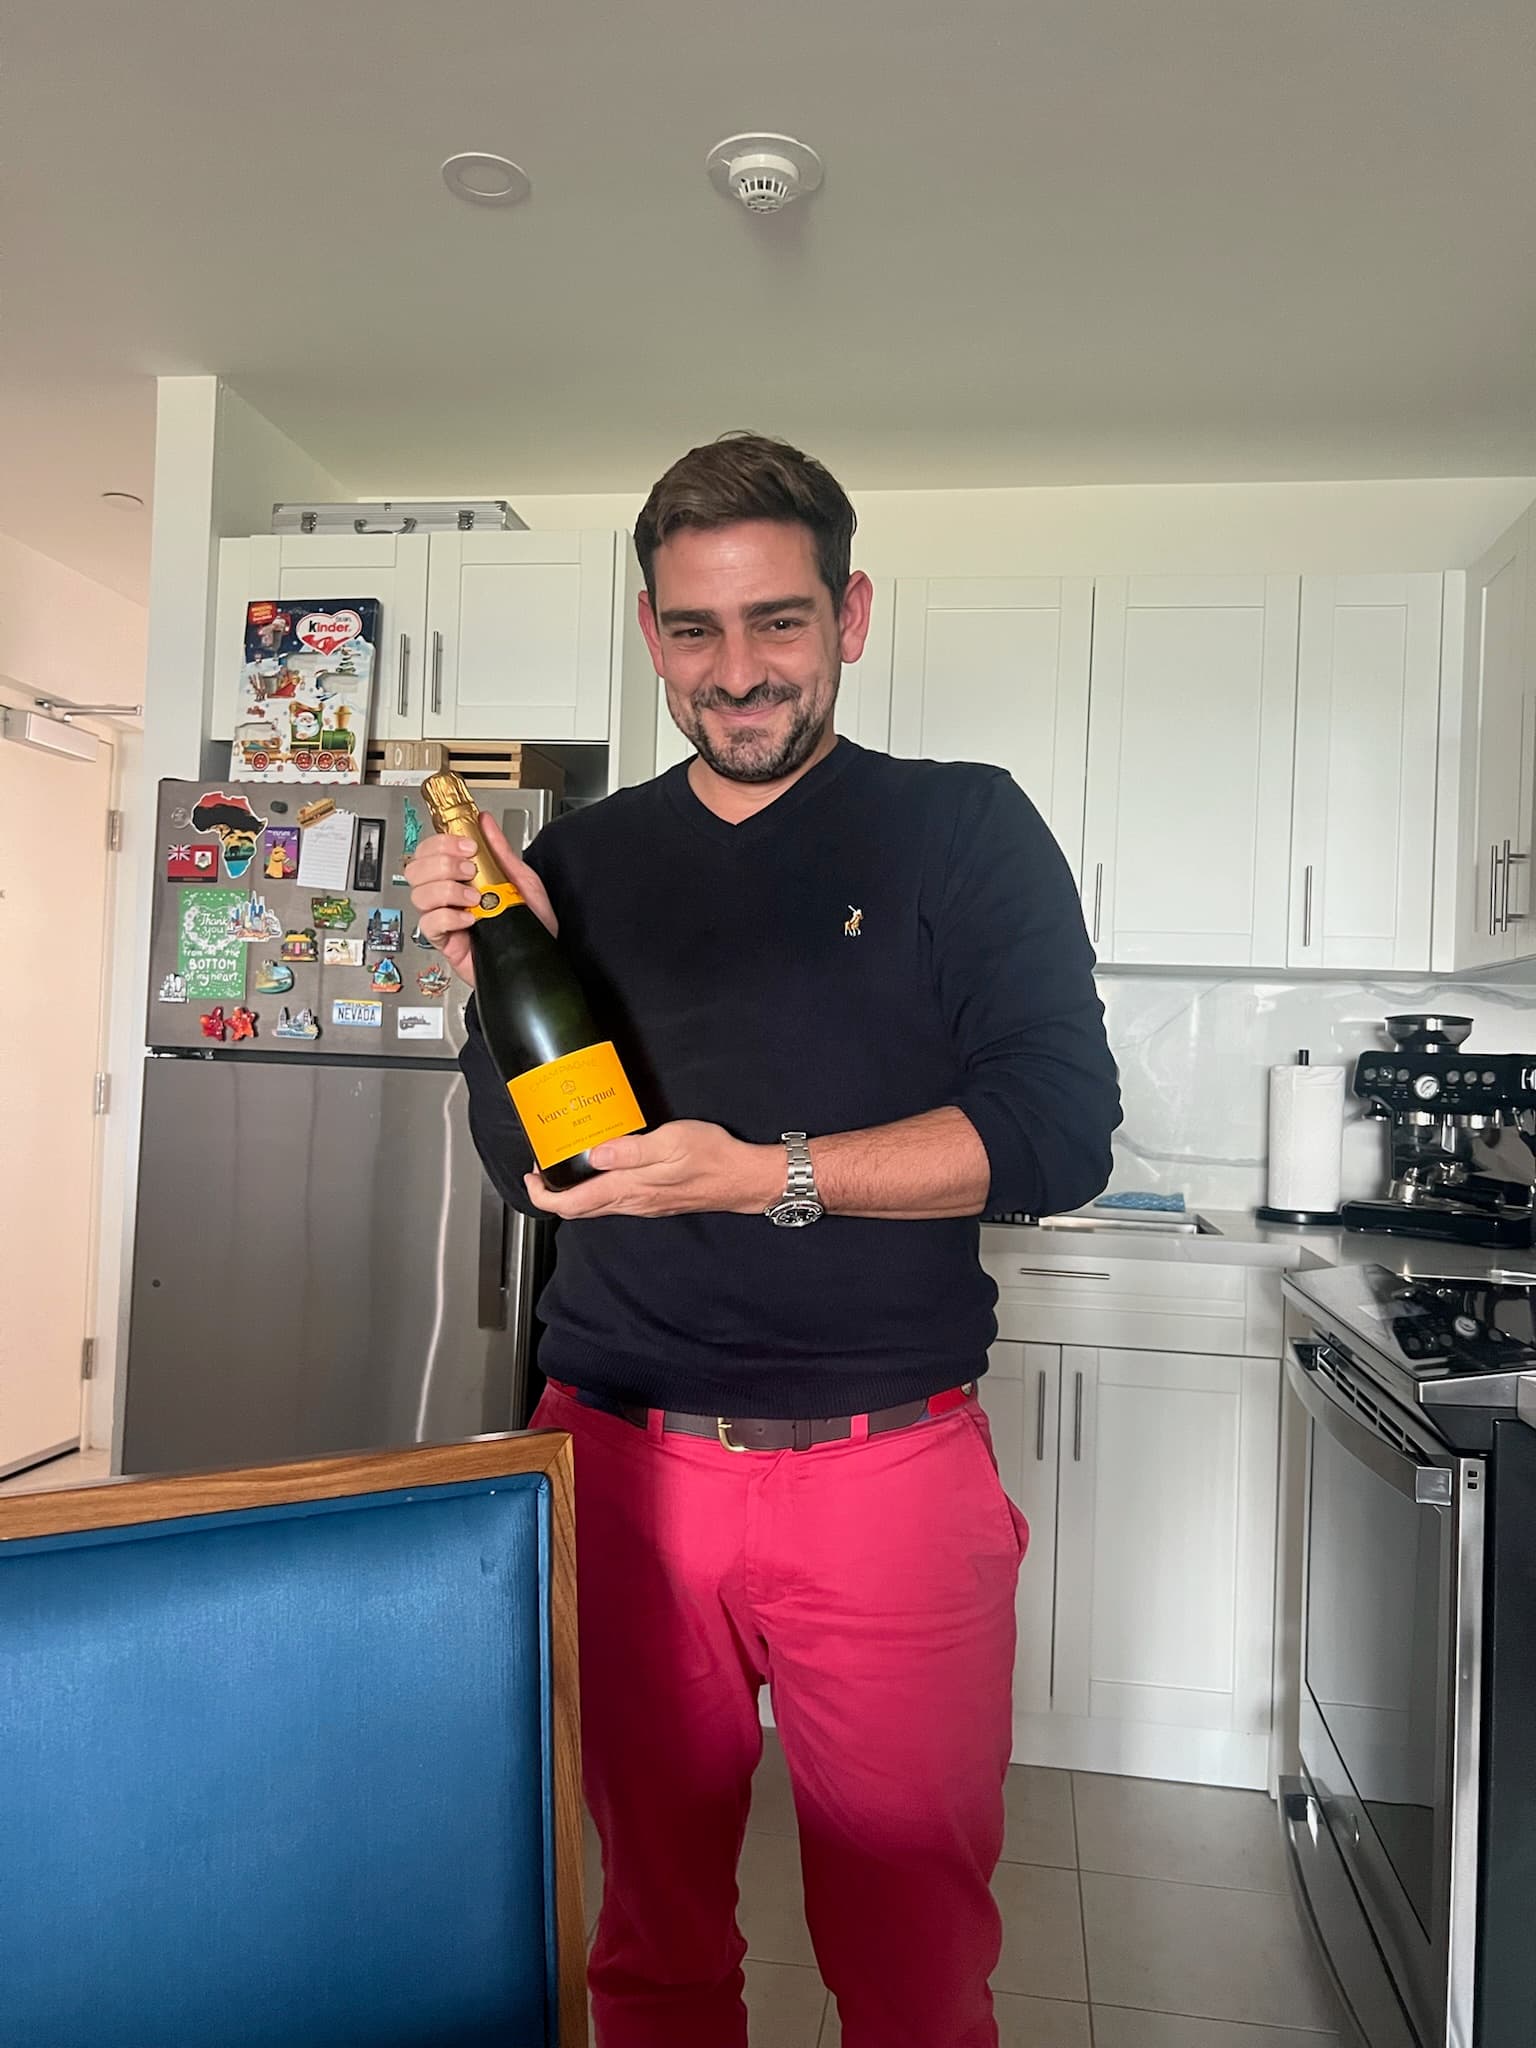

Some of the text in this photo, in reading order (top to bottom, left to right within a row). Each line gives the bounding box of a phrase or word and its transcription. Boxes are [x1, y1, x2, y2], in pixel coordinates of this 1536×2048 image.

[200, 913, 228, 926] Thank
[203, 927, 224, 943] you
[189, 959, 237, 971] BOTTOM
[210, 972, 239, 982] heart
[338, 1006, 376, 1022] NEVADA
[537, 1087, 617, 1125] Veuve Clicquot
